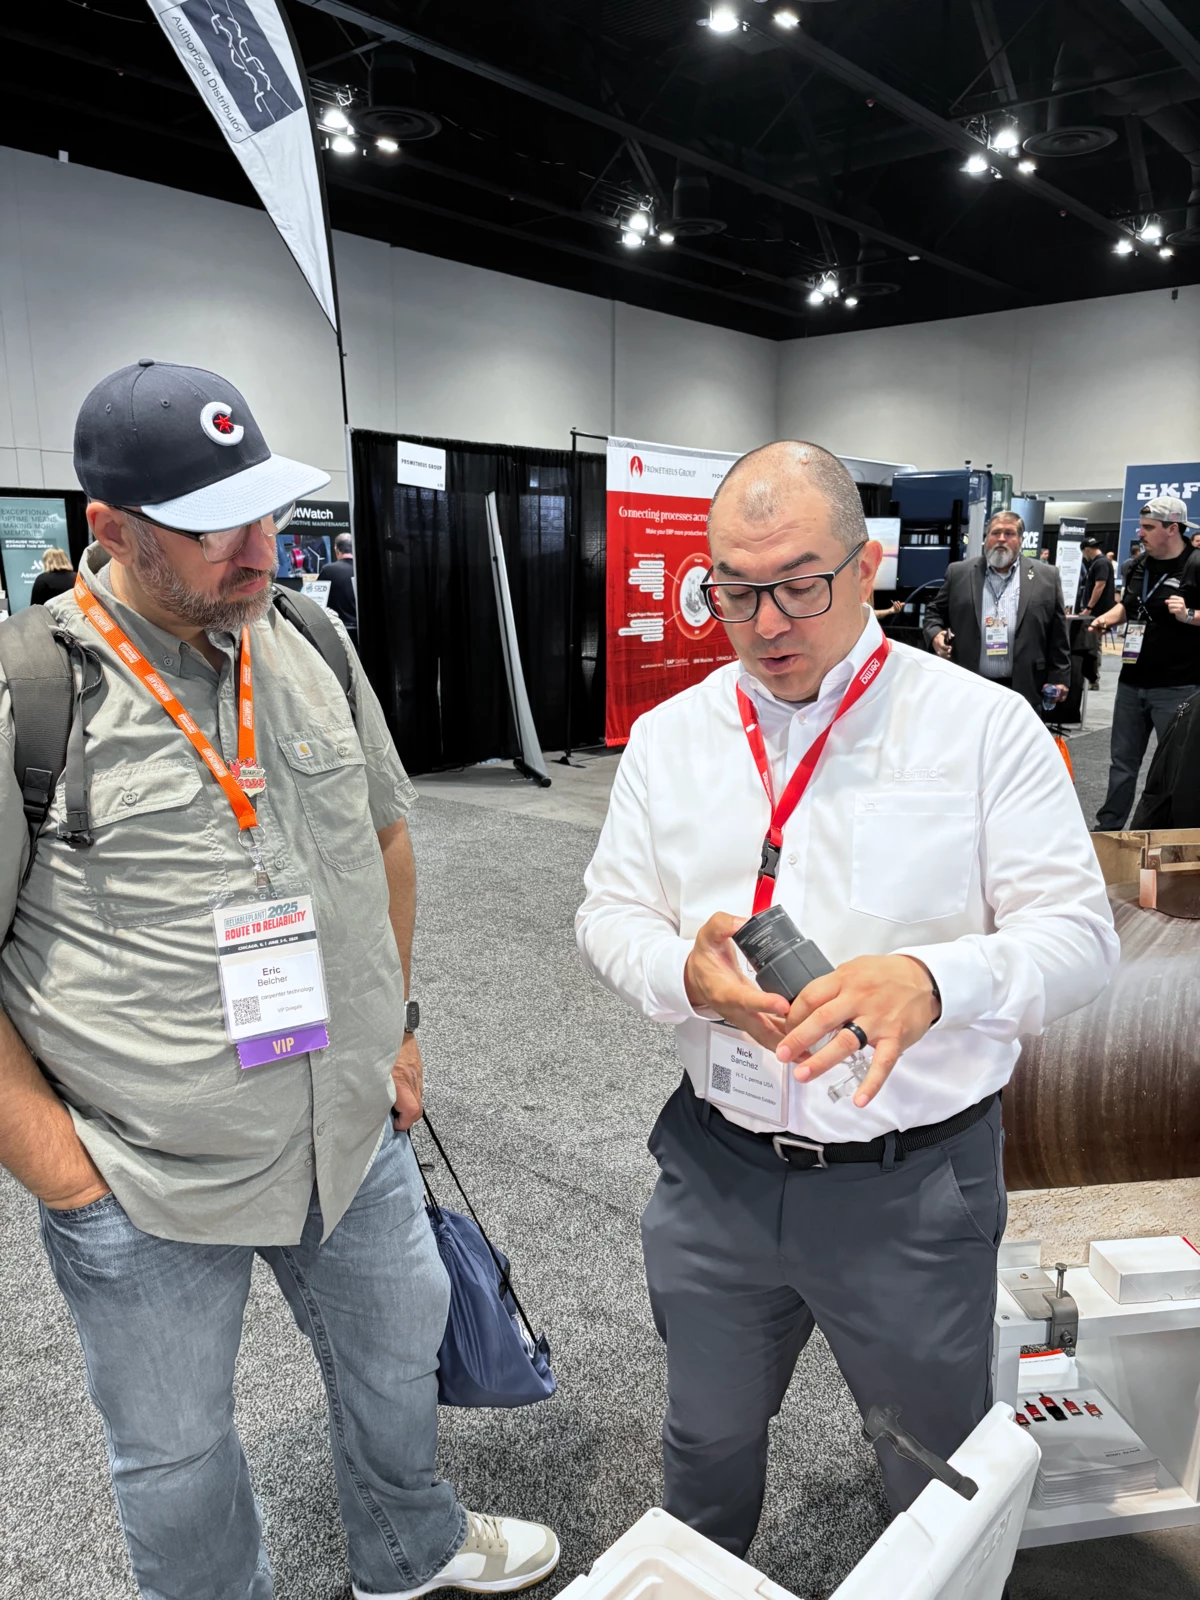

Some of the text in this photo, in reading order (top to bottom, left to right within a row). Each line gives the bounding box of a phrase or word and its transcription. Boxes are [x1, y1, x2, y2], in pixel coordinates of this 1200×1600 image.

[172, 16, 243, 133] Authorized Distributor
[1136, 482, 1200, 500] SKF
[1, 508, 50, 516] EXCEPTIONAL
[293, 507, 334, 519] tWatch
[618, 506, 708, 523] Connecting processes acro
[1022, 531, 1039, 548] RCE
[860, 657, 881, 685] perma
[268, 901, 298, 919] 2025
[225, 910, 306, 940] ROUTE TO RELIABILITY
[262, 966, 281, 976] Eric
[257, 976, 288, 987] Belcher
[260, 986, 314, 1000] carpenter technology
[272, 1036, 295, 1055] VIP
[736, 1046, 753, 1059] Nick
[730, 1054, 759, 1070] Sanchez
[763, 1080, 774, 1089] USA
